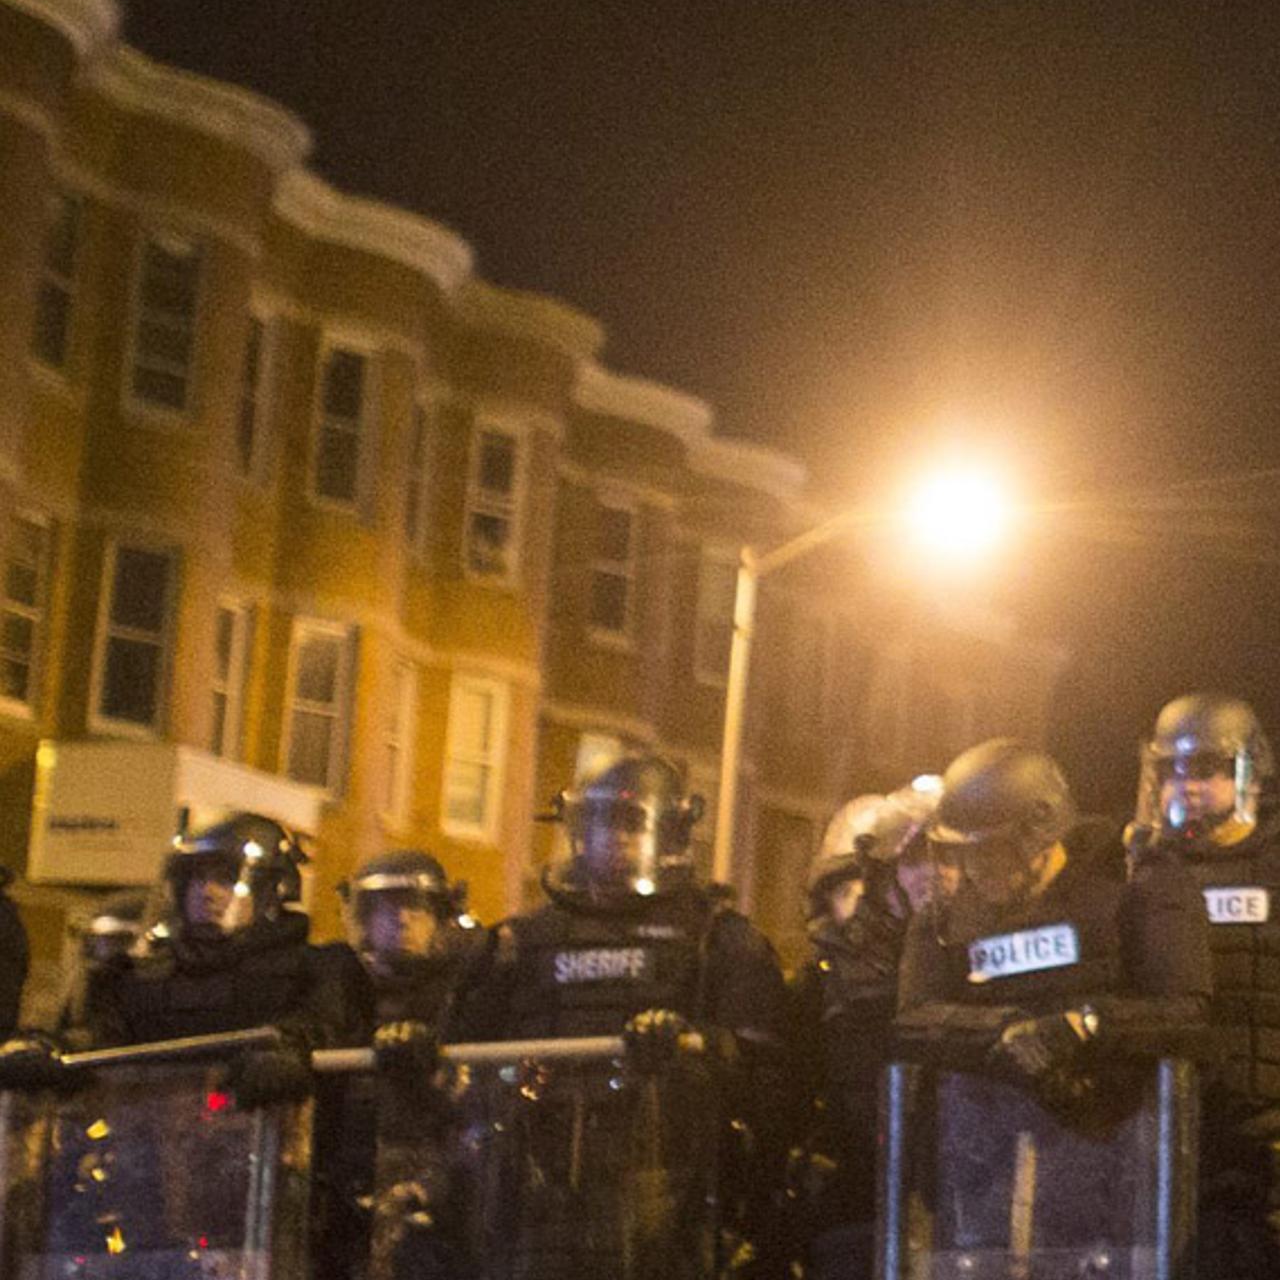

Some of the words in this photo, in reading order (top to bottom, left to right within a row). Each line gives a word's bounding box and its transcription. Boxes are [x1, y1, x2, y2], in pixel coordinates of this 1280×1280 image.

[1210, 895, 1260, 918] ICE
[554, 949, 645, 983] SHERIFF
[974, 933, 1067, 971] POLICE
